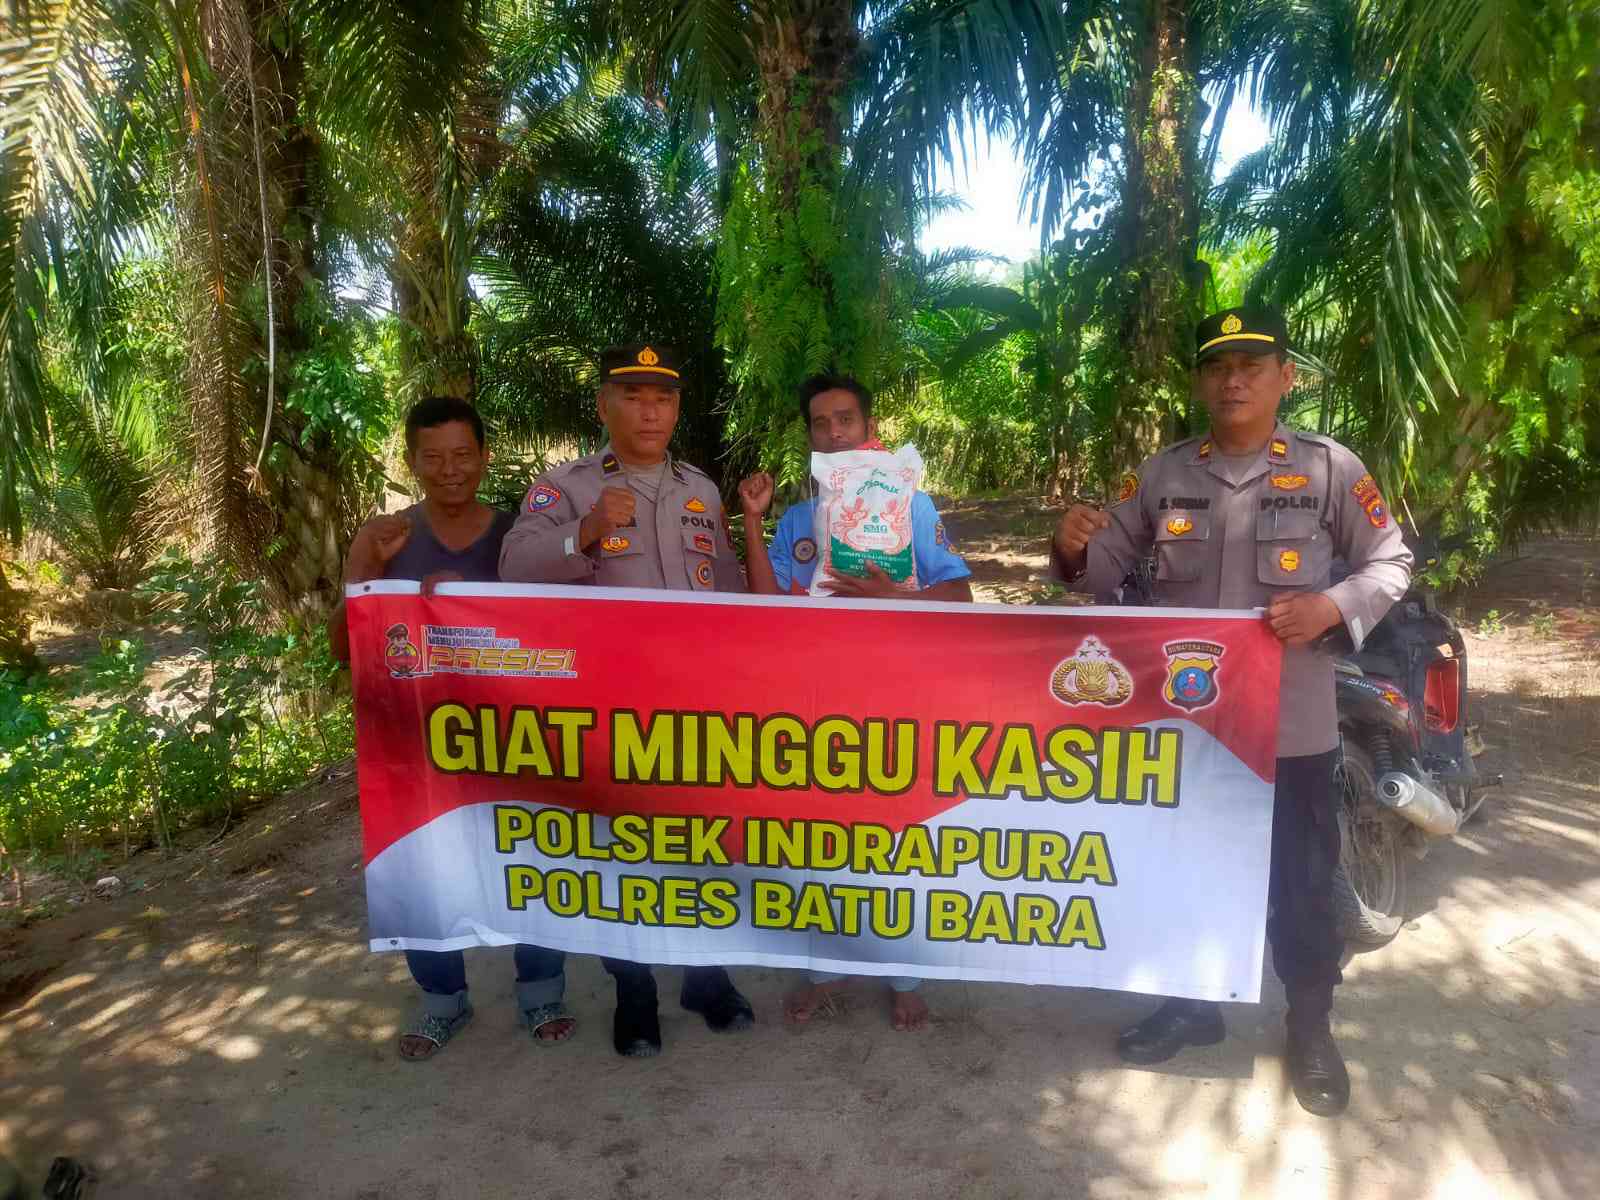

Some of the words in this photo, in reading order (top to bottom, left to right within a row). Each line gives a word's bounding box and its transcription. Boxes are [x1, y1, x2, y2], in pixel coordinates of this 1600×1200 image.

[1260, 496, 1319, 511] POLRI
[429, 647, 577, 671] PRESISI
[428, 702, 595, 779] GIAT
[611, 710, 918, 796] MINGGU
[933, 720, 1182, 807] KASIH
[493, 805, 732, 865] POLSEK
[744, 817, 1117, 886] INDRAPURA
[505, 865, 740, 928] POLRES
[751, 878, 914, 940] BATU
[927, 888, 1105, 949] BARA
